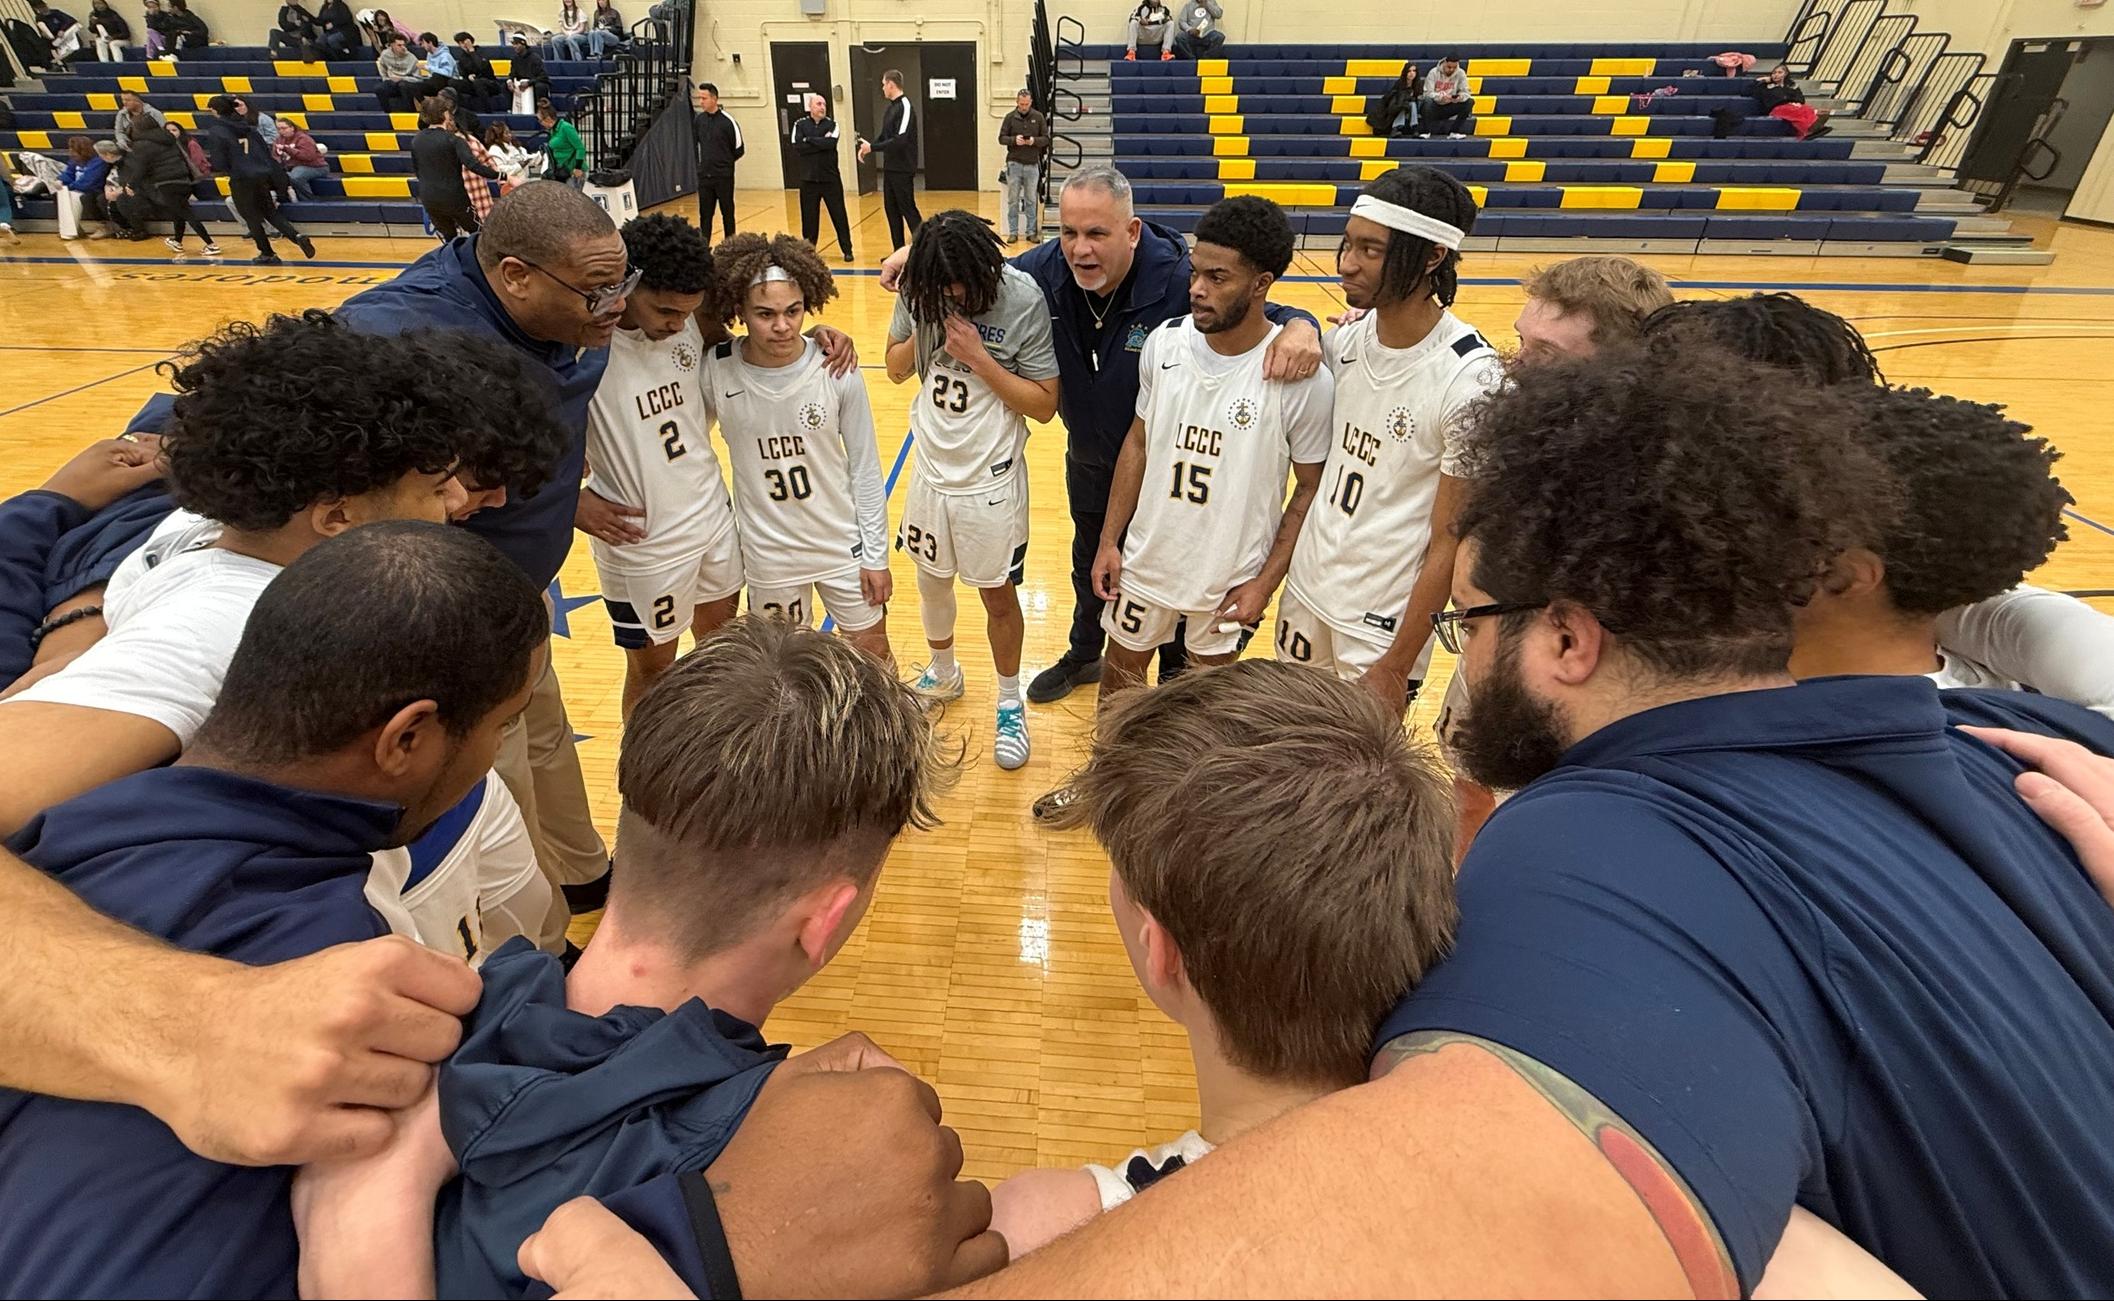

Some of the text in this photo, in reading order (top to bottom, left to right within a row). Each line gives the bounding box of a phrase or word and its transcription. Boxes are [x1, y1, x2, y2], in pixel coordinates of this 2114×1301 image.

[238, 138, 249, 154] 7
[636, 381, 684, 420] LCCC
[933, 374, 968, 413] 23
[659, 420, 687, 460] 2
[757, 436, 806, 460] LCCC
[1176, 422, 1222, 457] LCCC
[1342, 422, 1381, 467] LCCC
[764, 465, 812, 501] 30
[1170, 461, 1211, 504] 15
[1329, 464, 1364, 517] 10
[908, 524, 937, 562] 23
[654, 595, 675, 628] 2
[1112, 592, 1146, 634] 15
[1279, 620, 1312, 662] 10
